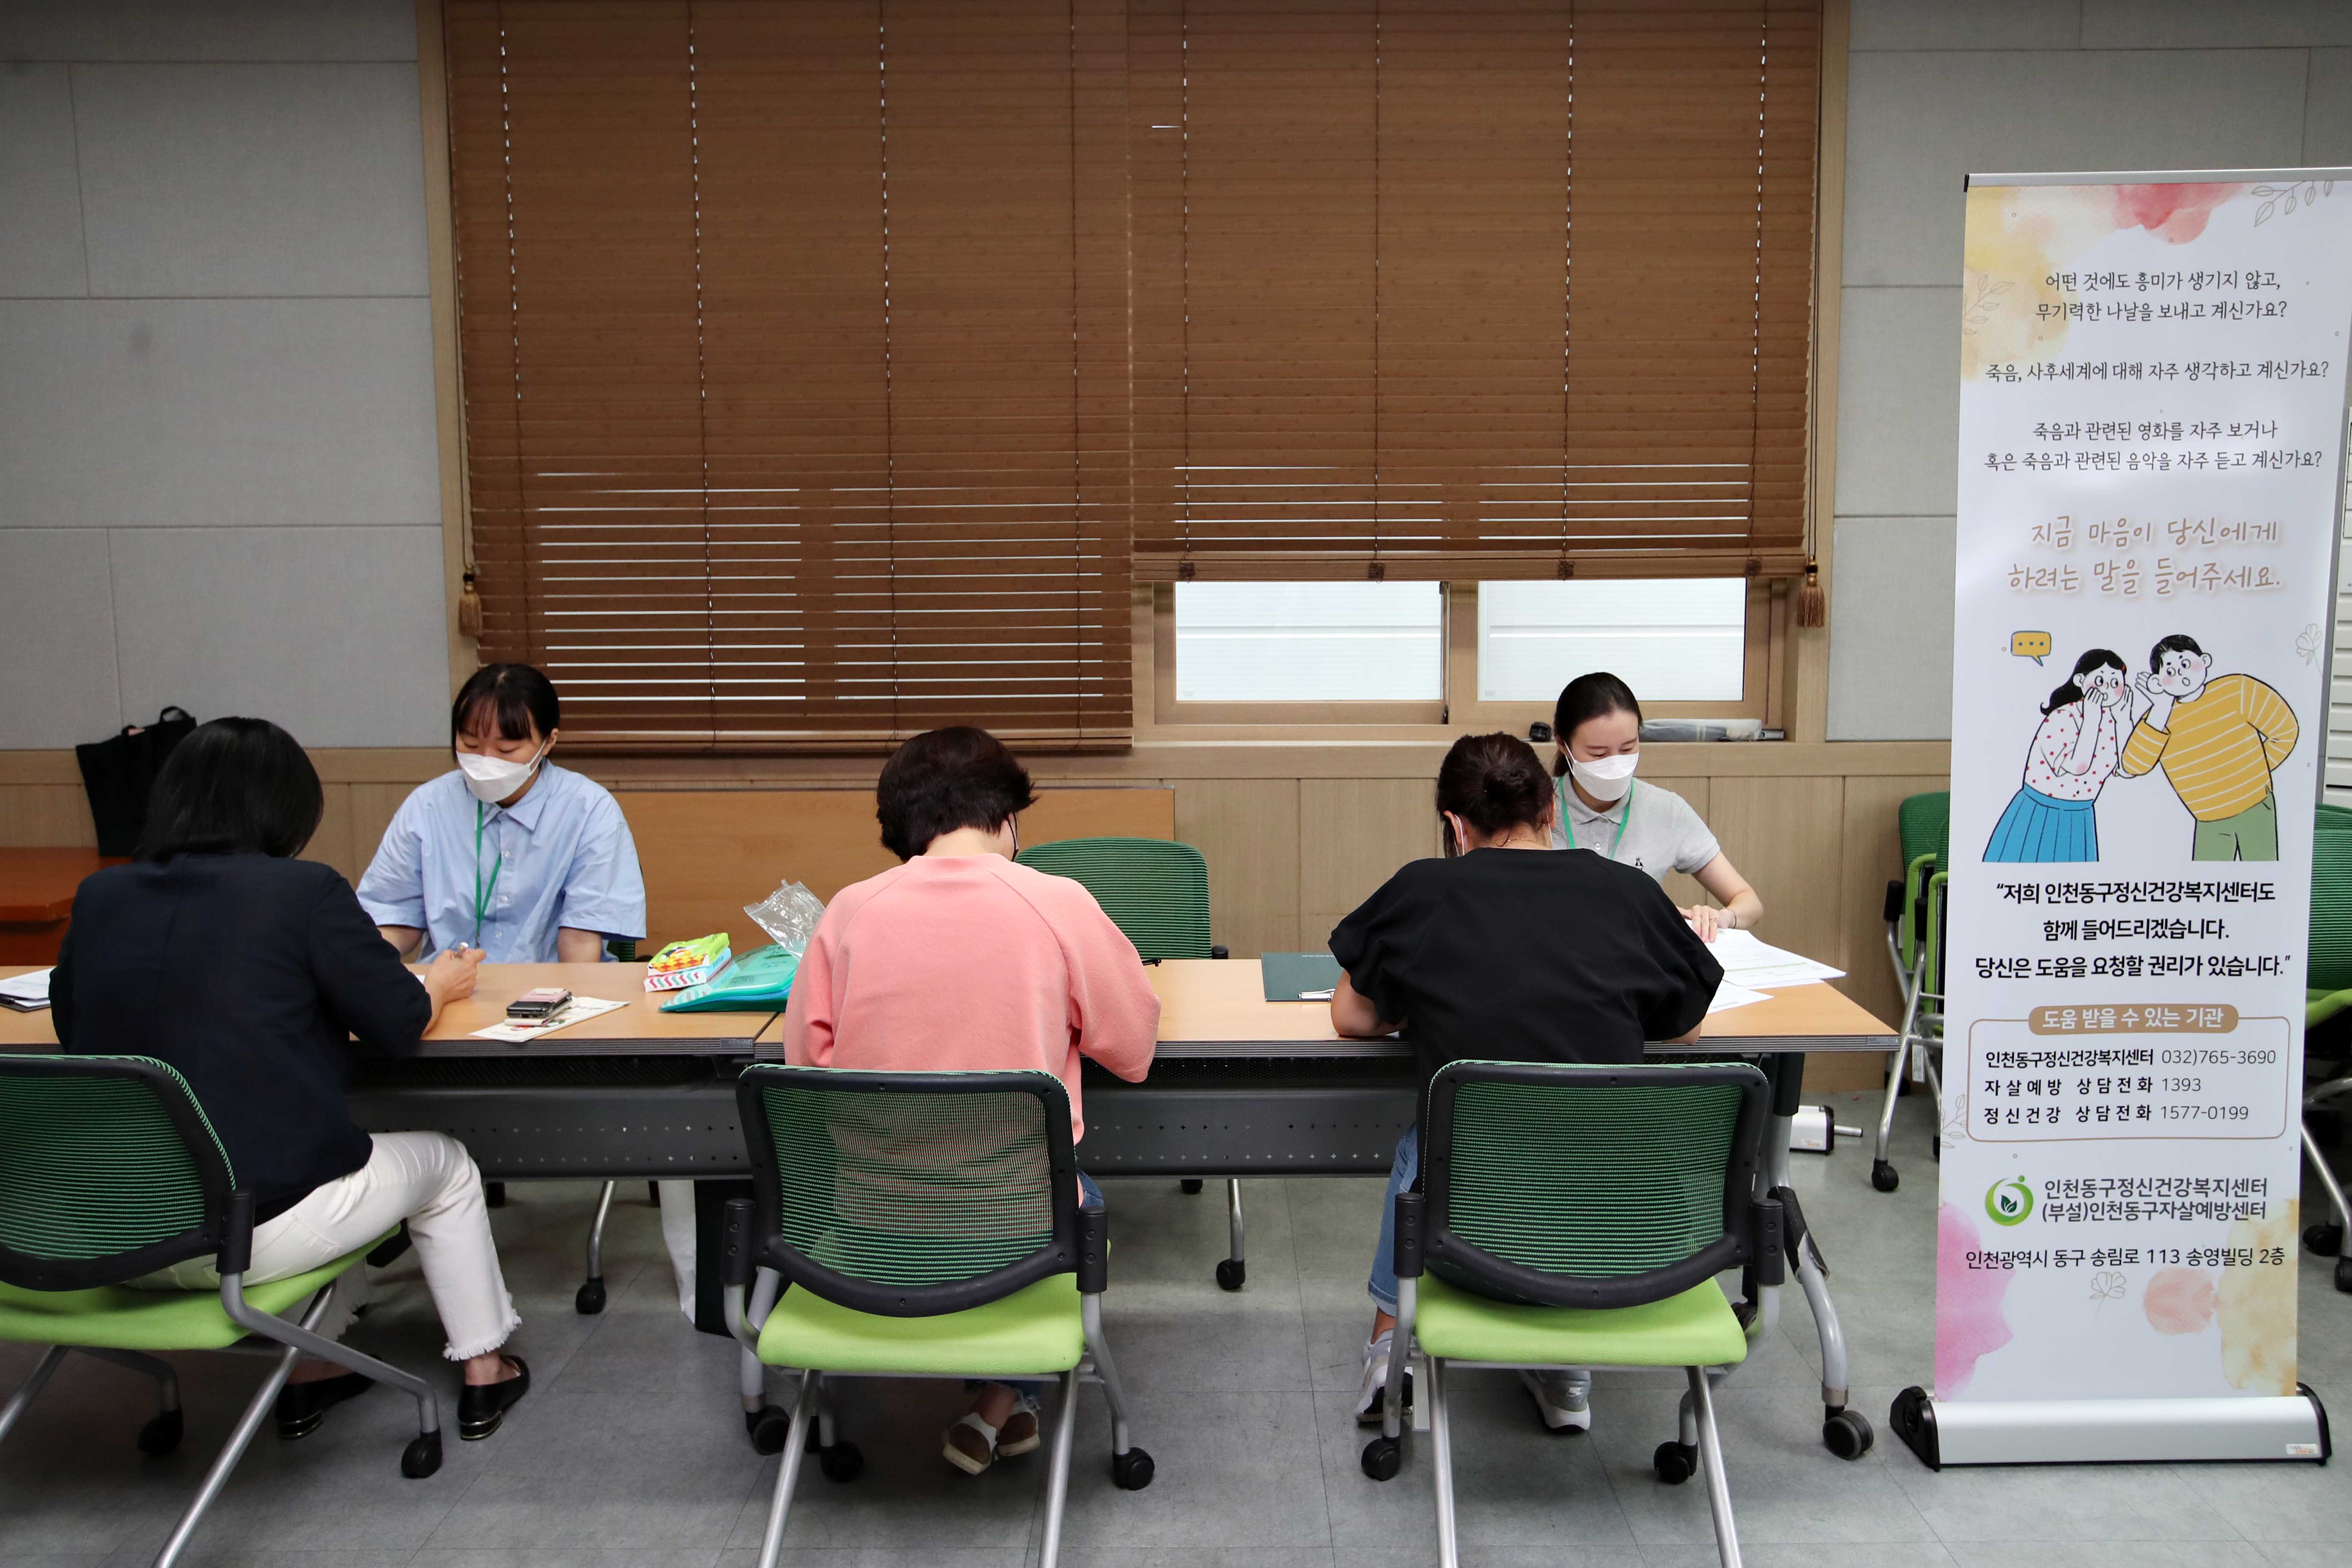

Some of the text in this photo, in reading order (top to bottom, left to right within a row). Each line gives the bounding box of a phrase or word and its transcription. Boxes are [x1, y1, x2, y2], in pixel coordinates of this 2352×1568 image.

[2046, 270, 2280, 292] 어떤 것에도 흥미가 생기지 않고,
[2035, 300, 2287, 322] 무기력한 나날을 보내고 계신가요?
[1985, 360, 2329, 383] 죽음, 사후세계에 대해 자주 생각하고 계신가요?
[2033, 420, 2278, 441] 죽음과 관련된 영화를 자주 보거나
[1984, 450, 2322, 472] 혹은 죽음과 관련된 음악을 자주 듣고 계신가요?
[2032, 516, 2276, 548] 지금 마음이 당신에게
[2008, 557, 2280, 594] 하려는 말을 들어주세요.
[2045, 881, 2275, 904] 인천동구정신건강복지센터도
[2043, 918, 2229, 941] 함께 들어드리겠습니다.
[1975, 957, 2032, 979] 당신은
[2035, 956, 2088, 978] 도움을
[2091, 955, 2144, 977] 요청할
[2148, 955, 2203, 976] 권리가
[2043, 1008, 2224, 1029] 도움 받을 수 있는 기관
[1986, 1048, 2276, 1069] 인천동구정신건강복지센터 032)765-3690
[2162, 1078, 2201, 1092] 1393
[2161, 1106, 2248, 1120] 1577-0199
[2045, 1177, 2267, 1200] 인천동구정신건강복지센터
[1966, 1246, 2285, 1270] 인천광역시 동구 송림로 113 송영빌딩 2층
